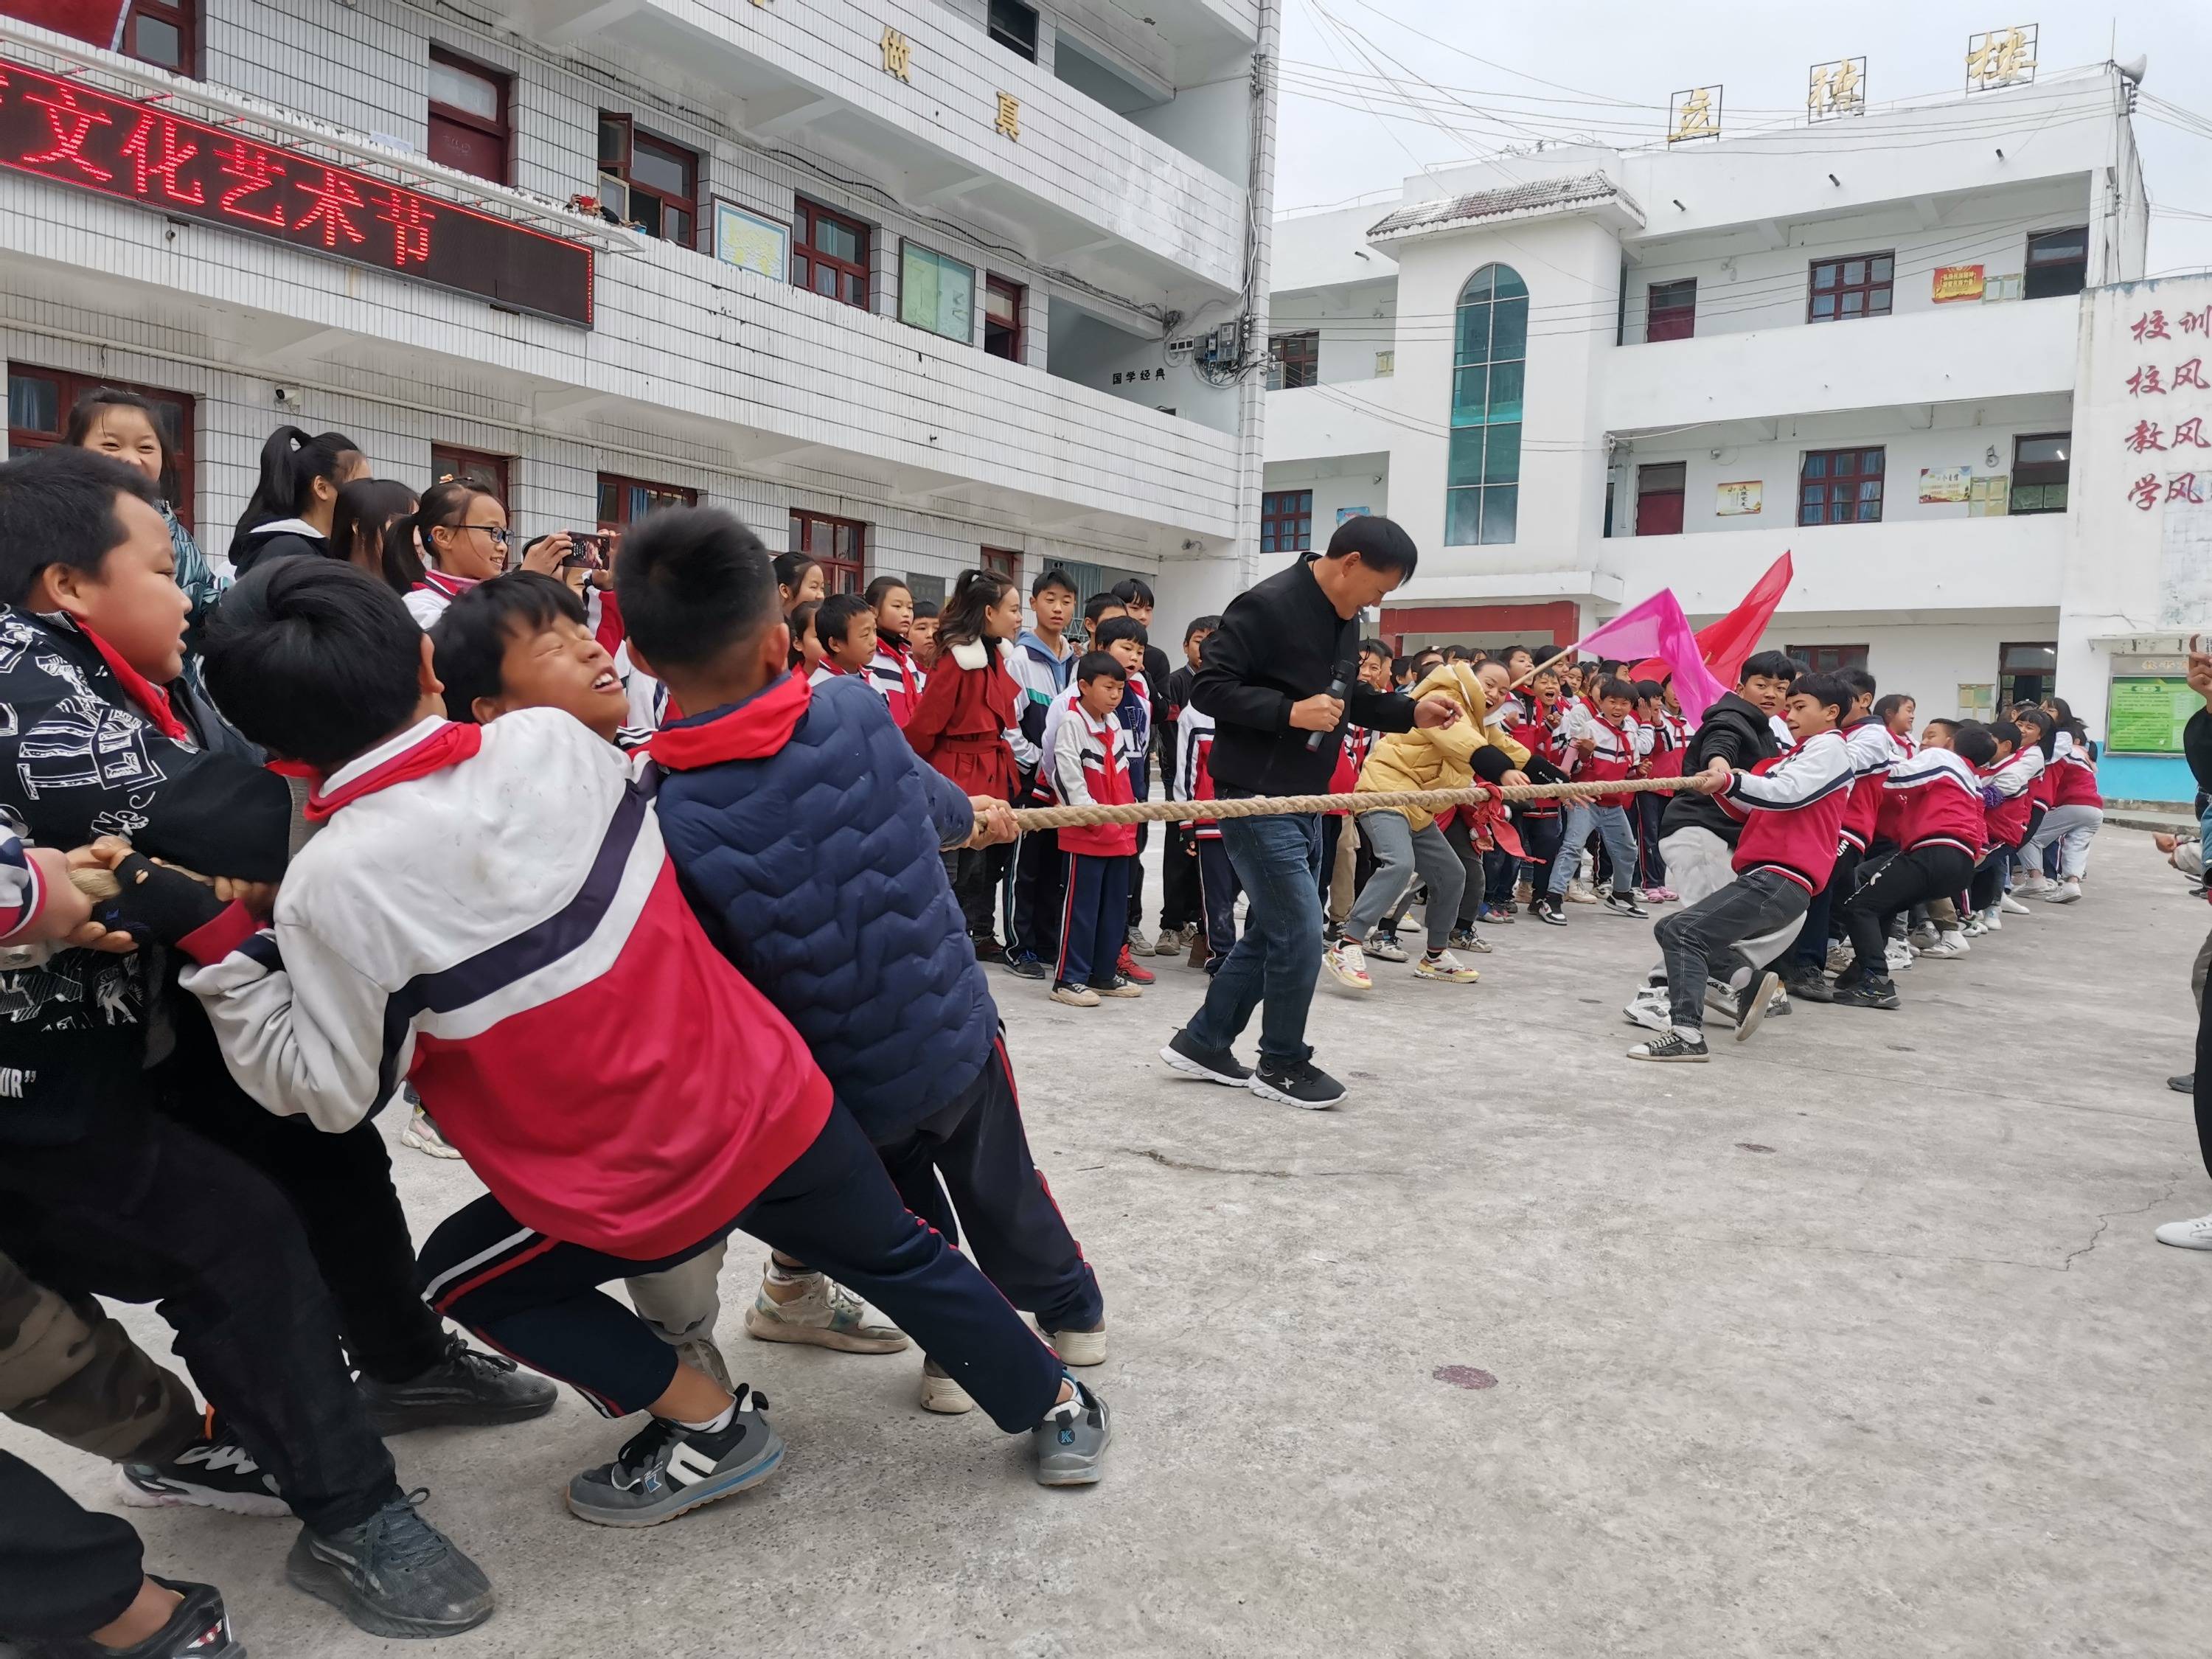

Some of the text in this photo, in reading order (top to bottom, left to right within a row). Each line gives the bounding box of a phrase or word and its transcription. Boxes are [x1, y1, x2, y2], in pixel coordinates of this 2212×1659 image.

[0, 75, 435, 266] 文化艺术节
[2129, 305, 2212, 345] 校训
[1112, 366, 1166, 386] 国学经典
[2125, 358, 2211, 398] 校风
[2124, 416, 2212, 454] 教风
[2127, 471, 2205, 511] 学风
